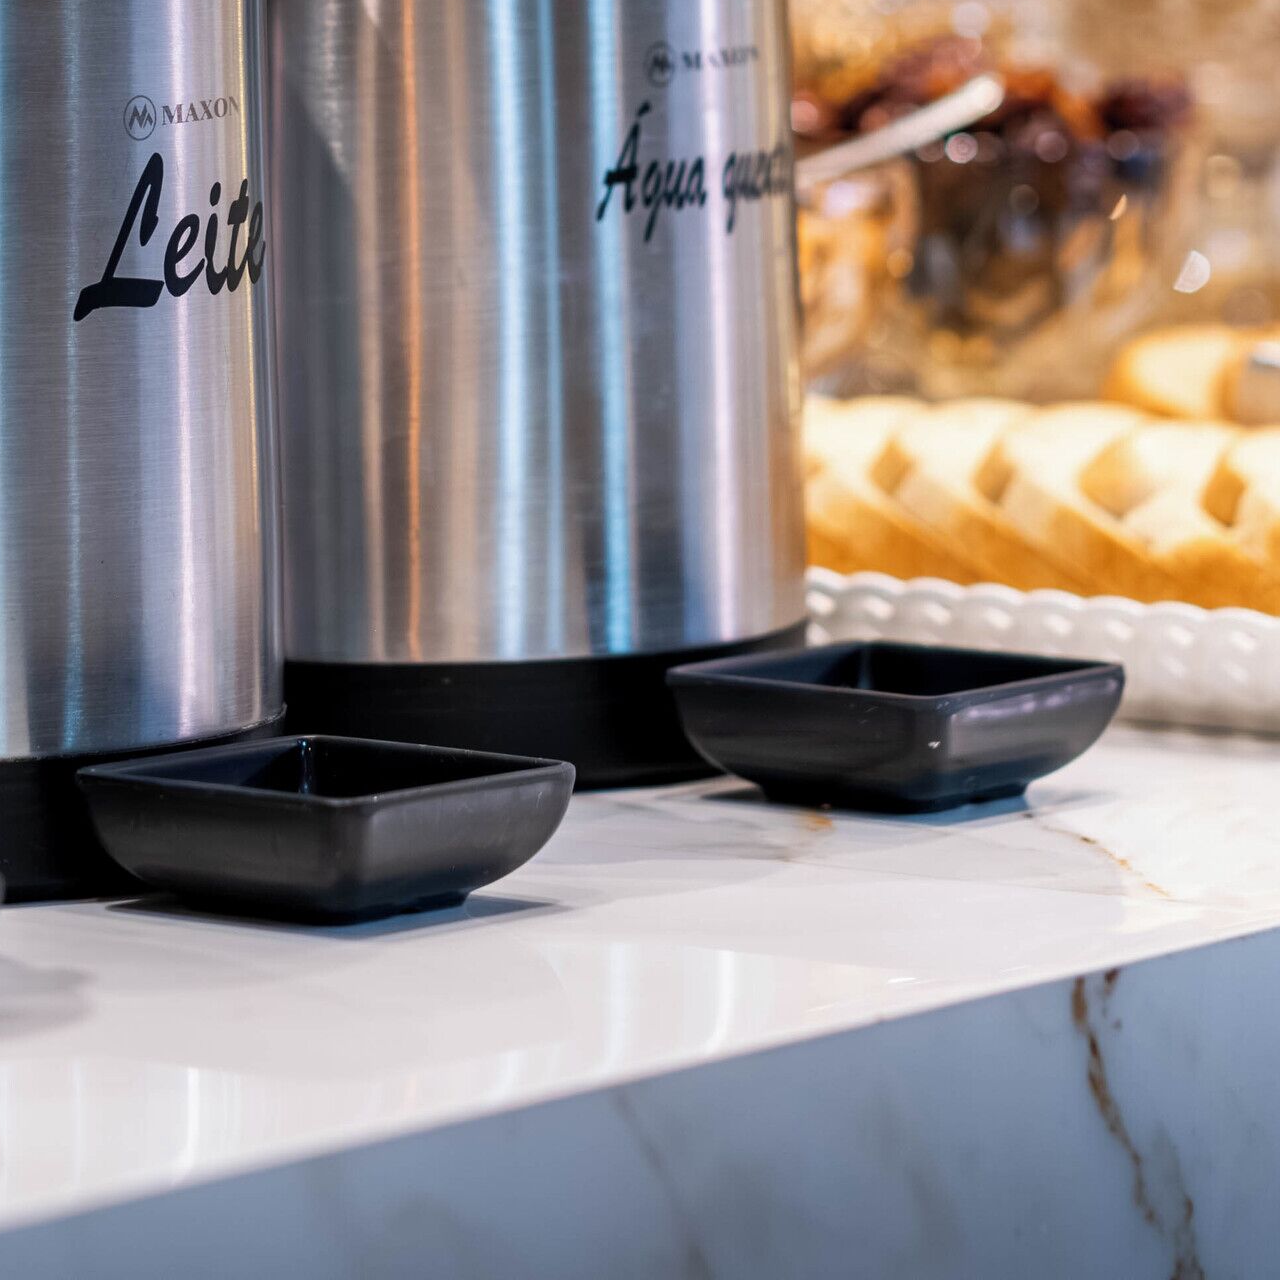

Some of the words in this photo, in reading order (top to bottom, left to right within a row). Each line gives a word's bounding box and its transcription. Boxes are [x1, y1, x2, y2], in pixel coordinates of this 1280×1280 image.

[161, 96, 240, 126] MAXON
[596, 102, 707, 242] Água
[73, 152, 267, 322] Leite
